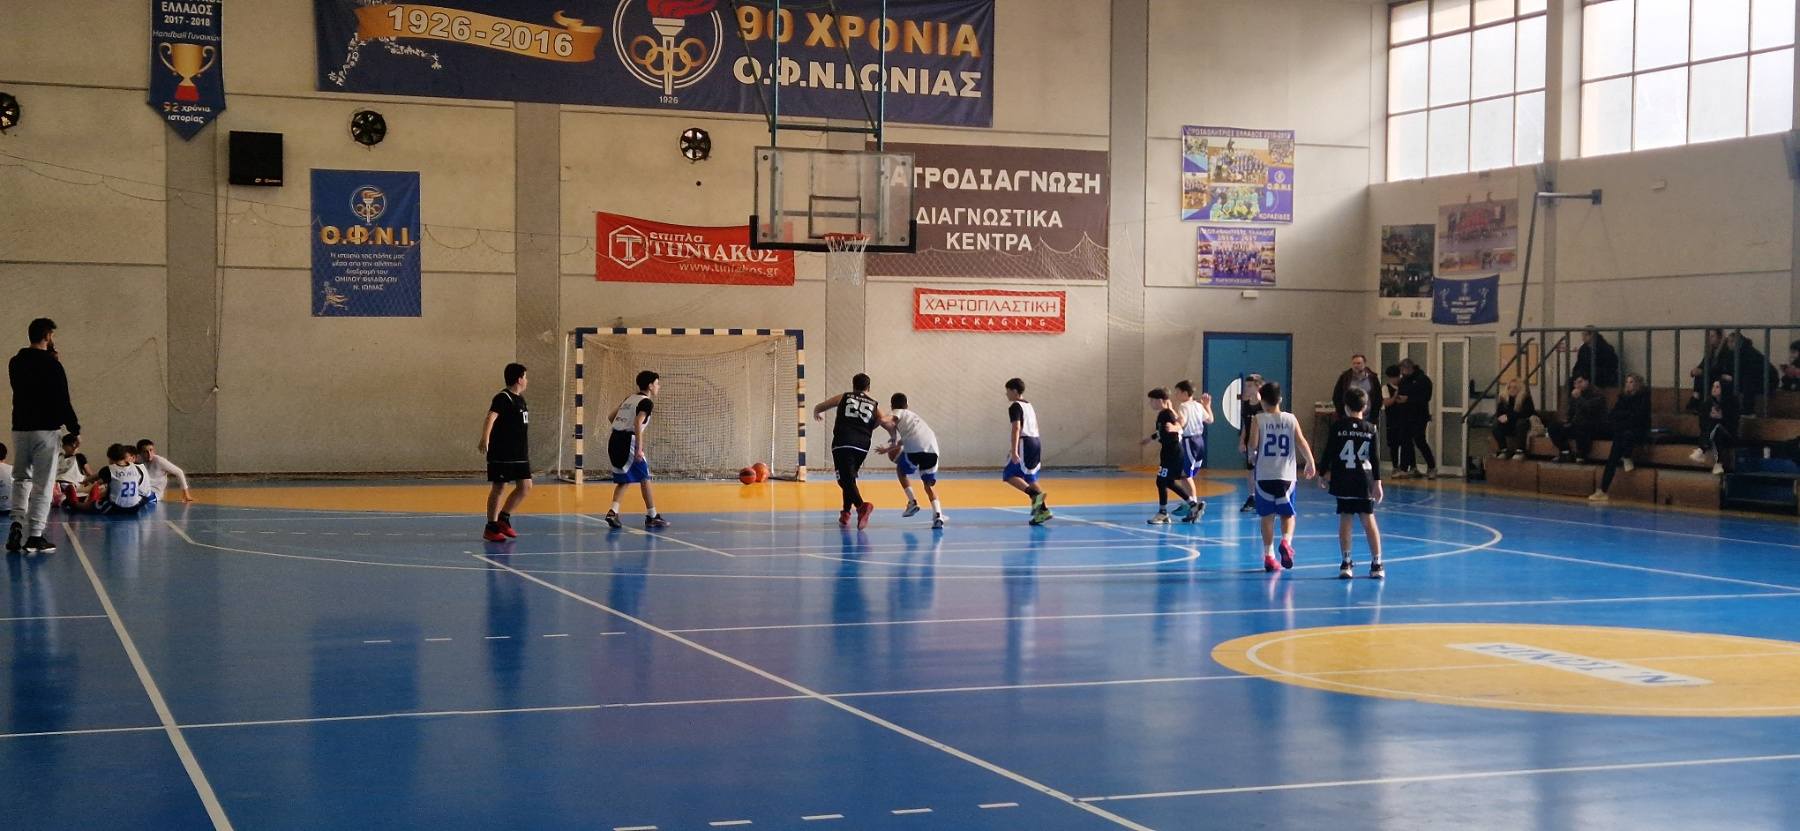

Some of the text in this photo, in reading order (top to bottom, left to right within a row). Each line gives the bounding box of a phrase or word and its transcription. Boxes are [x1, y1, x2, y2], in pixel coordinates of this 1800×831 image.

[161, 2, 213, 16] ΕΛΛΑΔΟΣ
[164, 15, 184, 24] 2017
[190, 17, 210, 26] 2018
[736, 5, 982, 58] 90 ΧΡΟΝΙΑ
[659, 95, 679, 104] 1926
[915, 207, 1063, 228] ΔΙΑΓΝΩΣΤΙΚΑ
[320, 224, 415, 246] Ο.Φ.Ν.Ι.
[946, 232, 1033, 252] ΚΕΝΤΡΑ
[649, 240, 778, 262] ΤΗΝΙΑΚΟΣ
[925, 298, 1056, 313] ΧΑΡΤΟΠΛΑΣΤΙΚΗ
[934, 317, 1046, 327] PACKAGING
[845, 398, 874, 423] 25
[1264, 433, 1290, 457] 29
[1340, 440, 1372, 470] 44
[121, 481, 136, 498] 23
